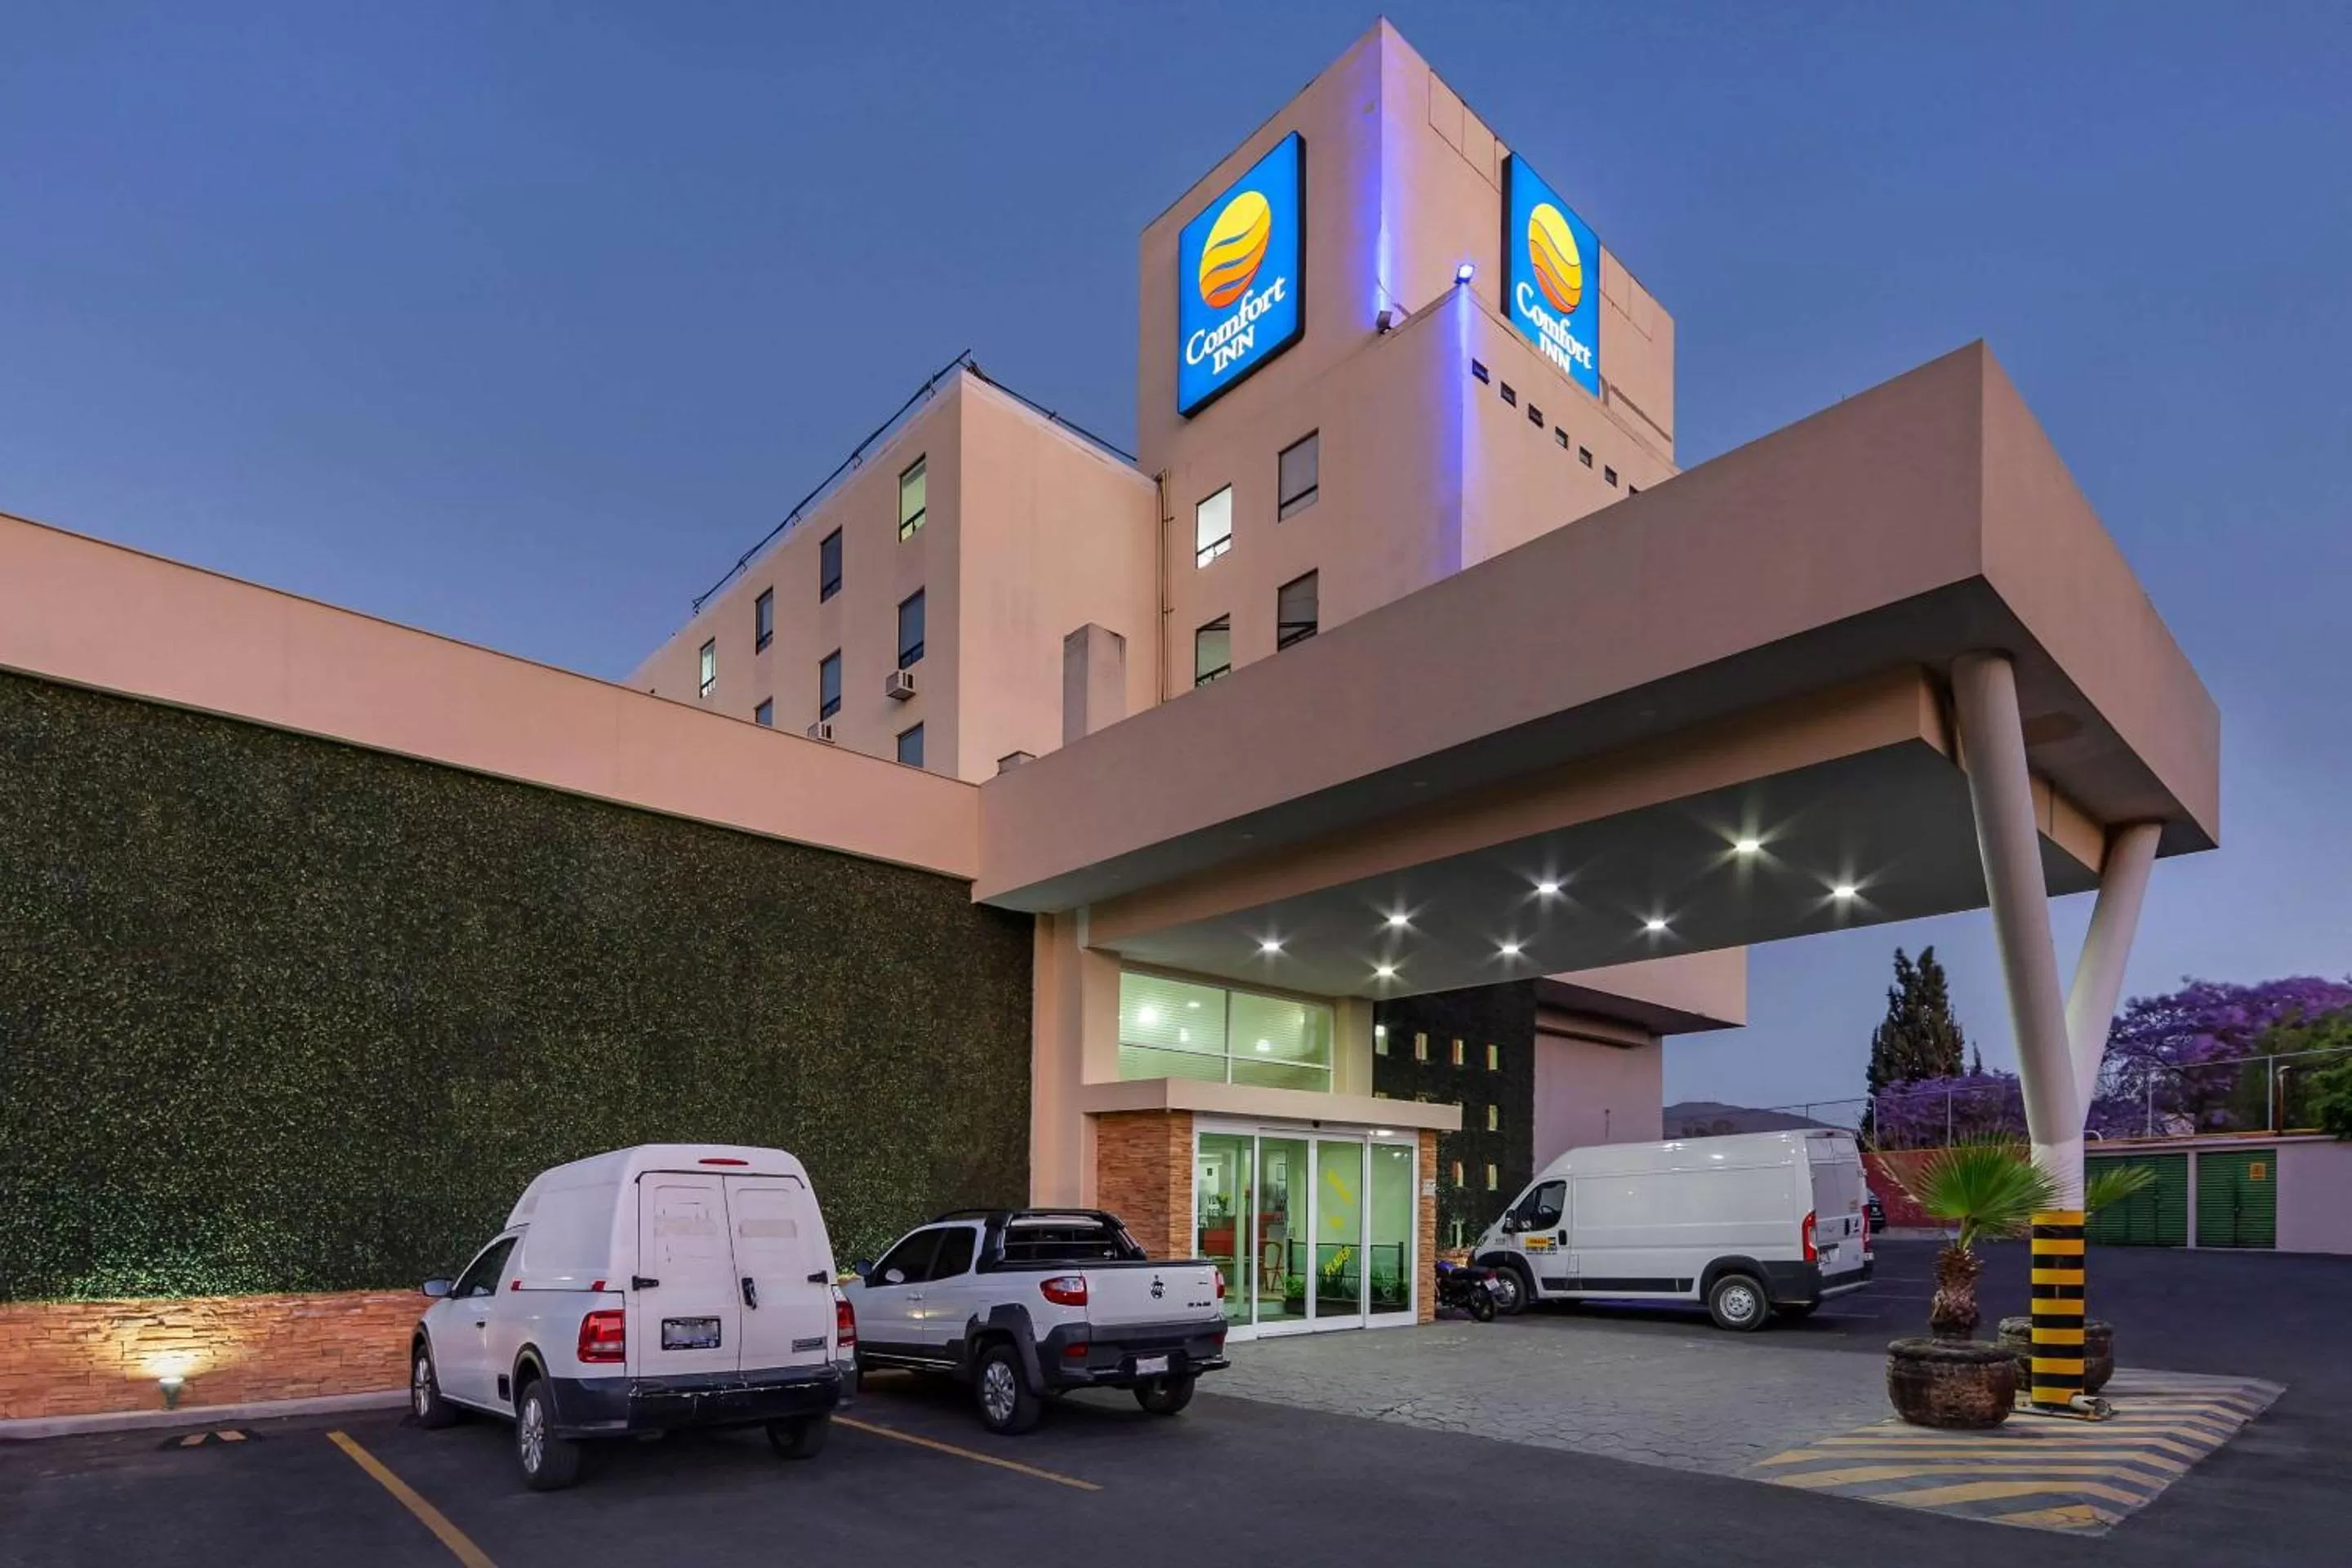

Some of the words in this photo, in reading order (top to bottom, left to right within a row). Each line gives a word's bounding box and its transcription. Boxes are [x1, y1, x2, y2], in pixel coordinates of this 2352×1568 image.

[1186, 275, 1286, 365] Comfort
[1212, 324, 1255, 376] INN
[1517, 282, 1593, 369] Comfort
[1539, 331, 1571, 374] INN
